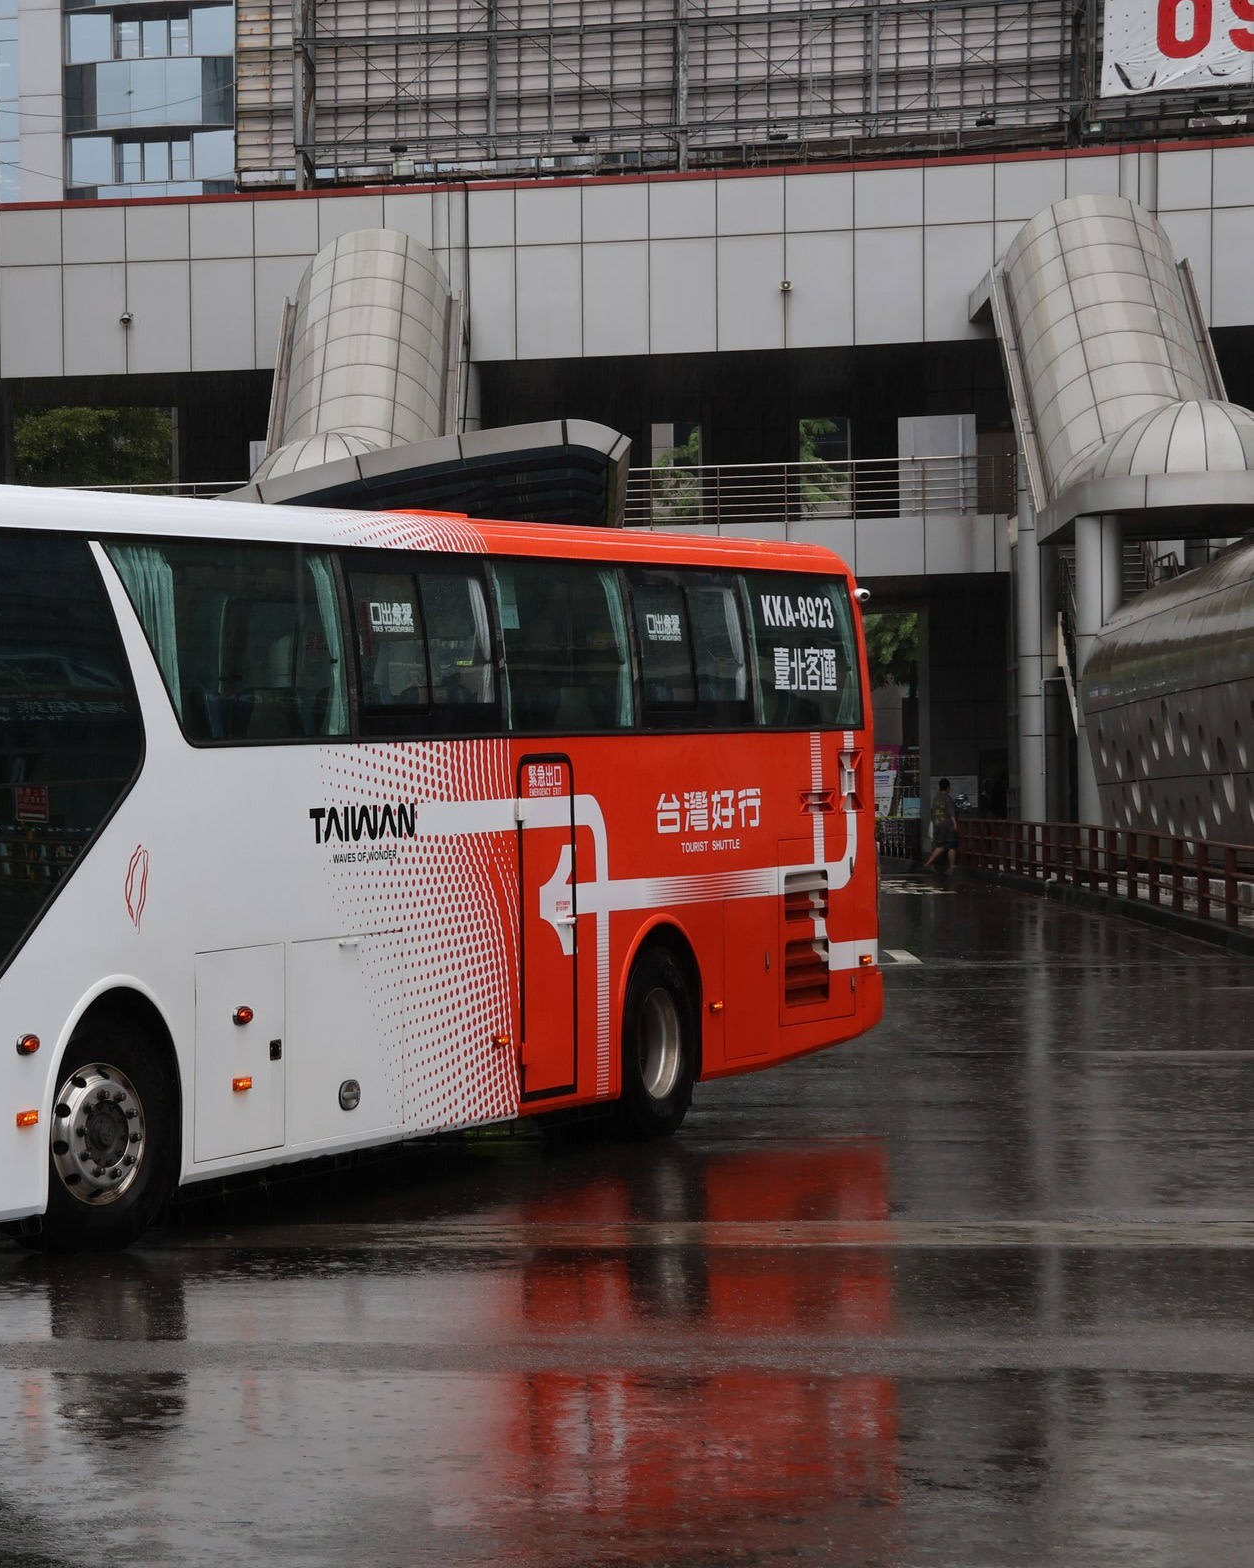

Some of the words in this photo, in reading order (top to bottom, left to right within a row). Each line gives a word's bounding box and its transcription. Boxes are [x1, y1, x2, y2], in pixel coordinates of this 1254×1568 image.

[760, 594, 834, 629] KKA-8923
[773, 646, 838, 691] 臺北客運
[528, 765, 562, 786] 緊急出口
[529, 788, 551, 797] EMERGENCY
[552, 787, 562, 796] EXIT
[309, 802, 415, 844] TAIWAN
[656, 788, 762, 834] 台灣好行
[332, 853, 356, 864] WAVES
[357, 852, 366, 862] OF
[367, 849, 397, 862] WONDER
[681, 841, 708, 853] TOURIST
[711, 838, 741, 851] SHUTTLE
